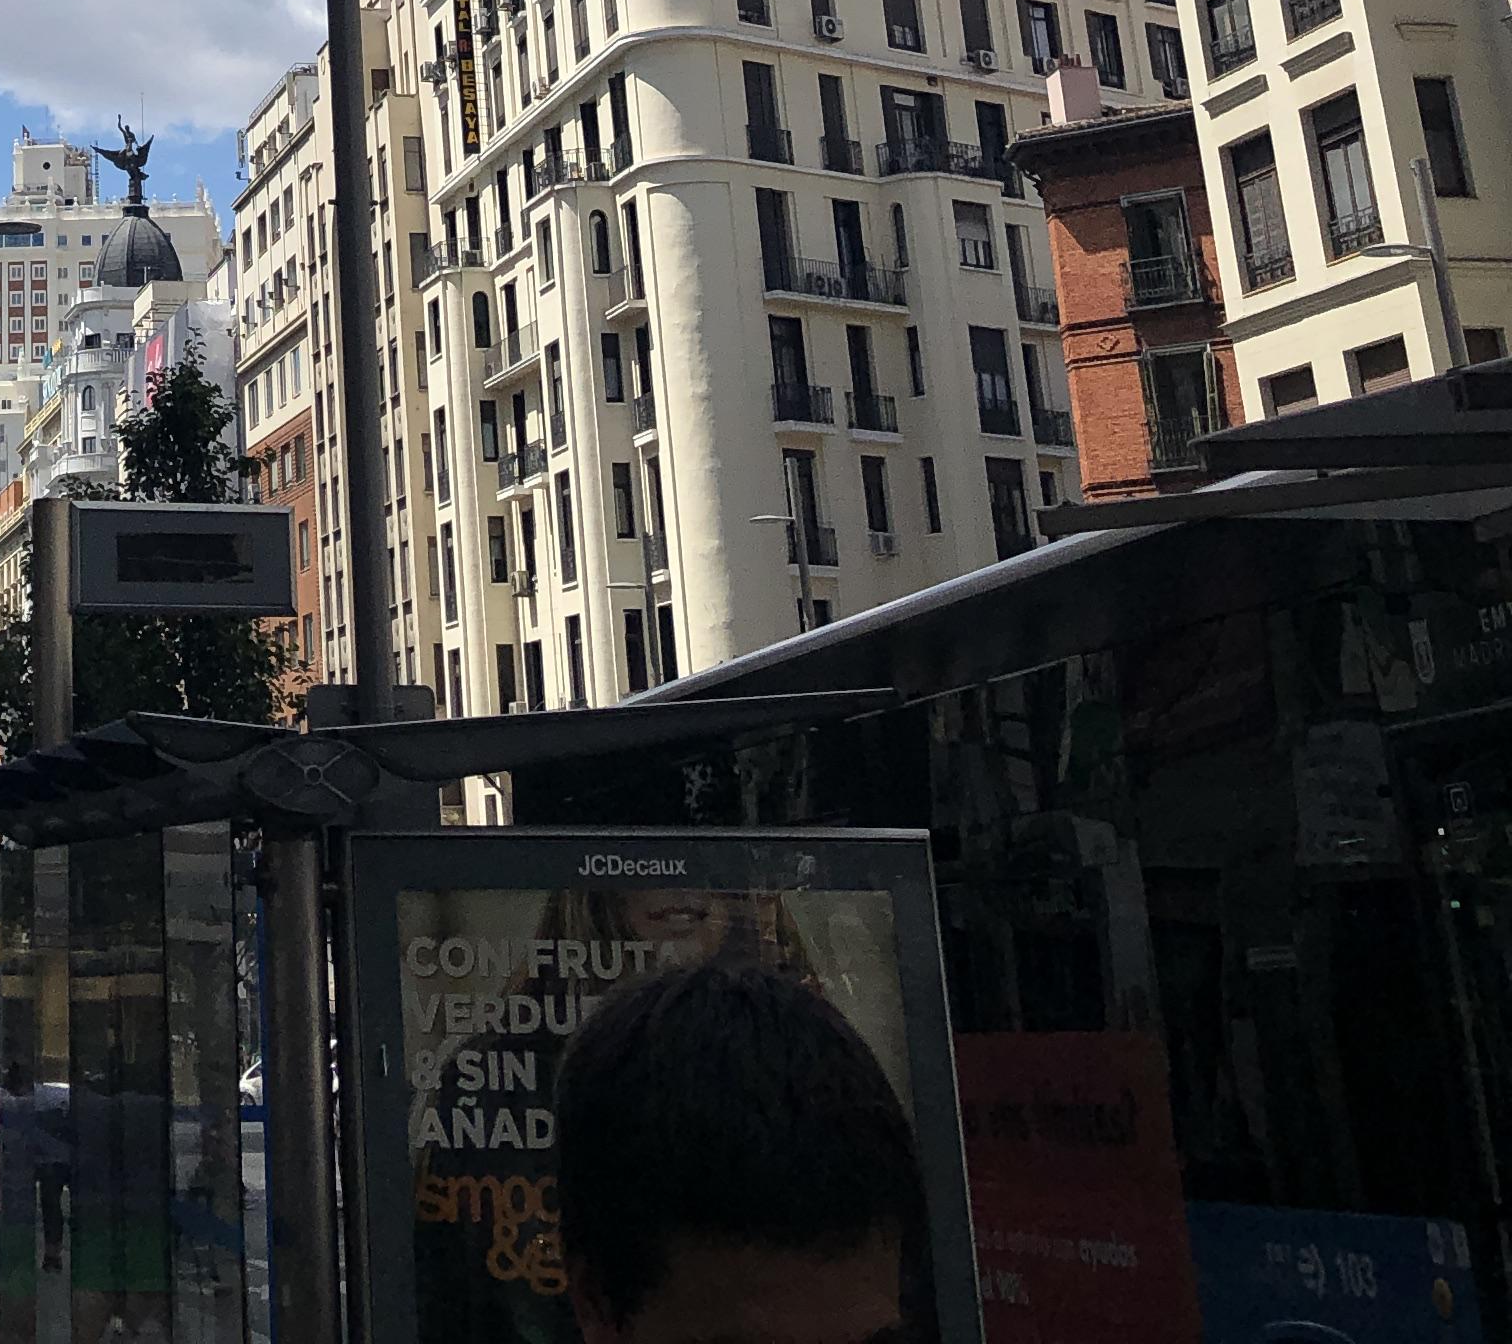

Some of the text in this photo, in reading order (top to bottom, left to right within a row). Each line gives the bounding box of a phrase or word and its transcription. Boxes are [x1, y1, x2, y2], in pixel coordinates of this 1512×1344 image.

[460, 59, 479, 144] BESAYA
[578, 854, 687, 876] JCDecaux
[406, 936, 512, 979] CON
[410, 1049, 537, 1092] & SIN
